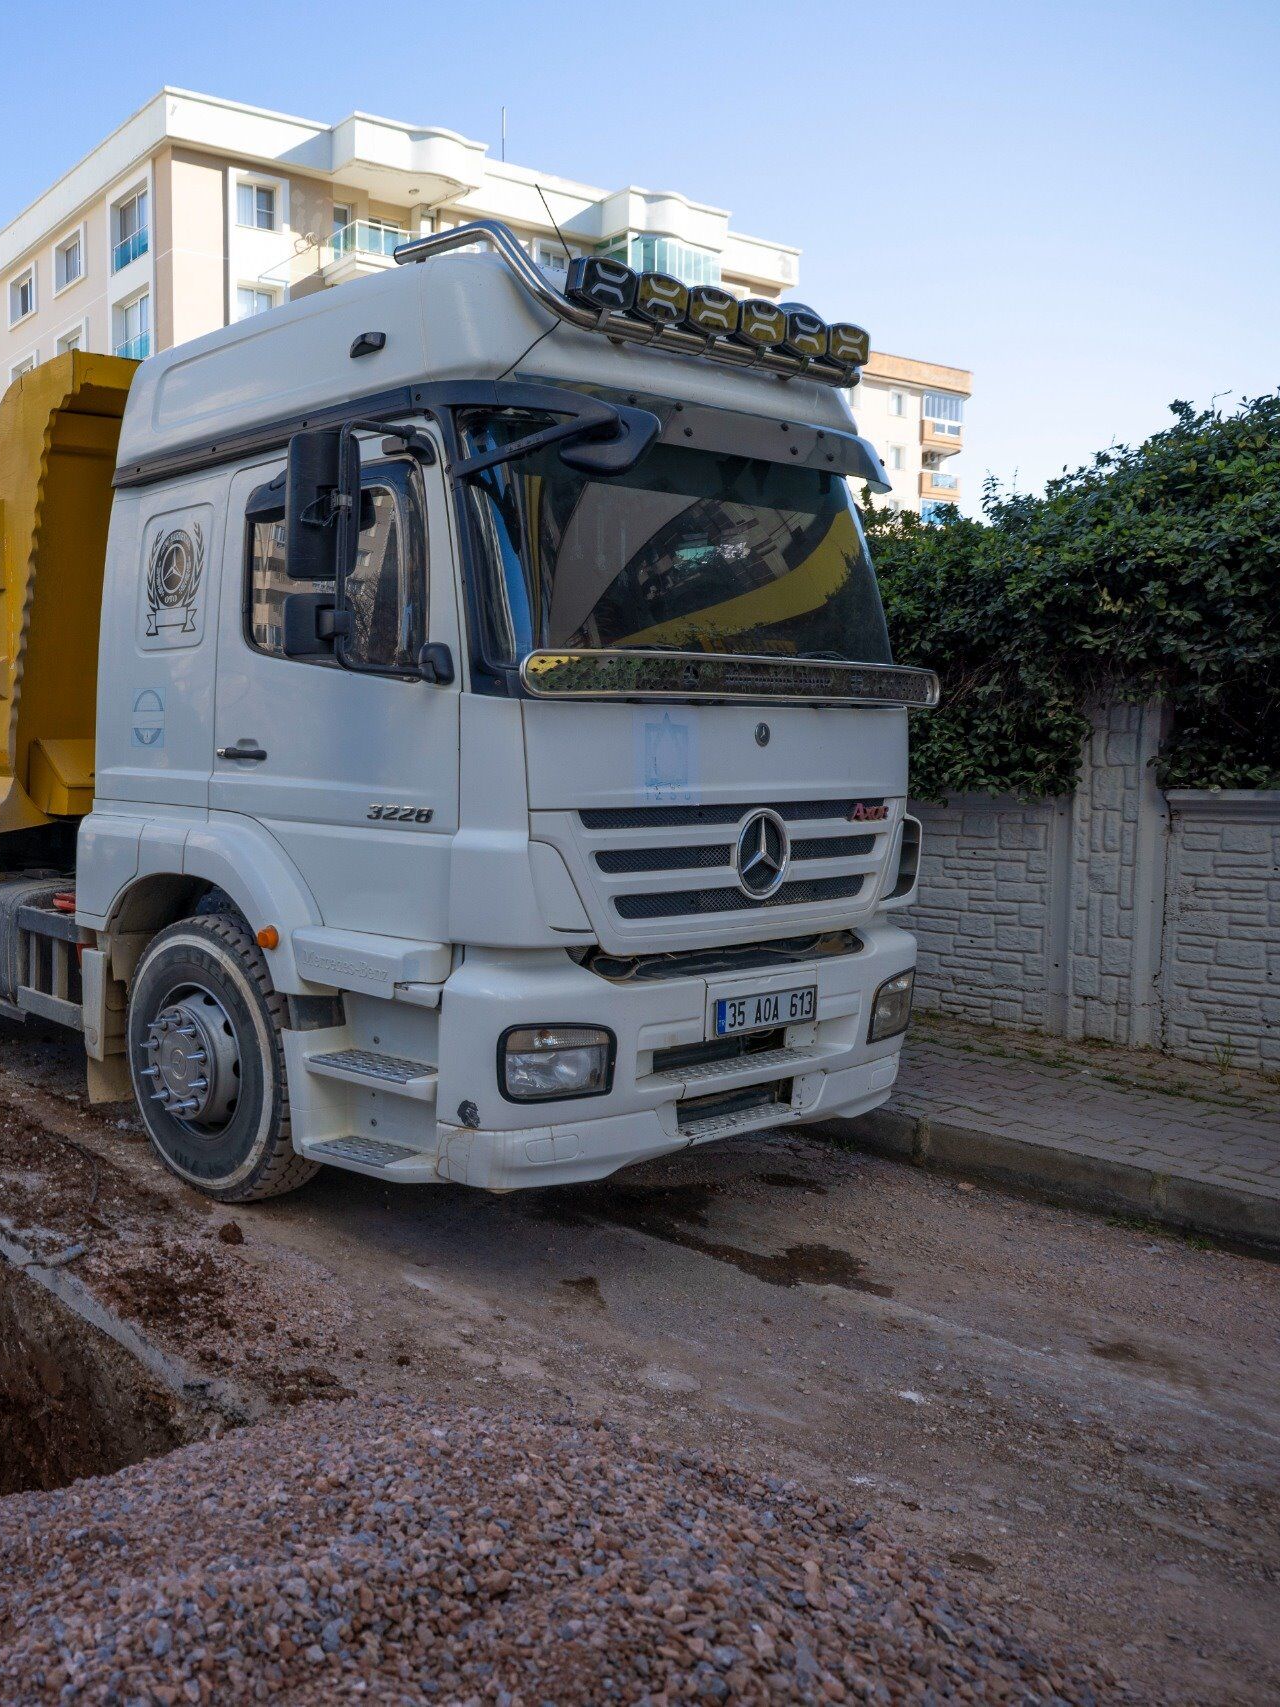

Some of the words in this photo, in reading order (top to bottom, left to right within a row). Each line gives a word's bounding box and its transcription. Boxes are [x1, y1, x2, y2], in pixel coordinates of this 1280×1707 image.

[366, 804, 435, 823] 3228
[728, 1001, 746, 1028] 35
[754, 996, 780, 1024] AOA
[789, 990, 814, 1018] 613
